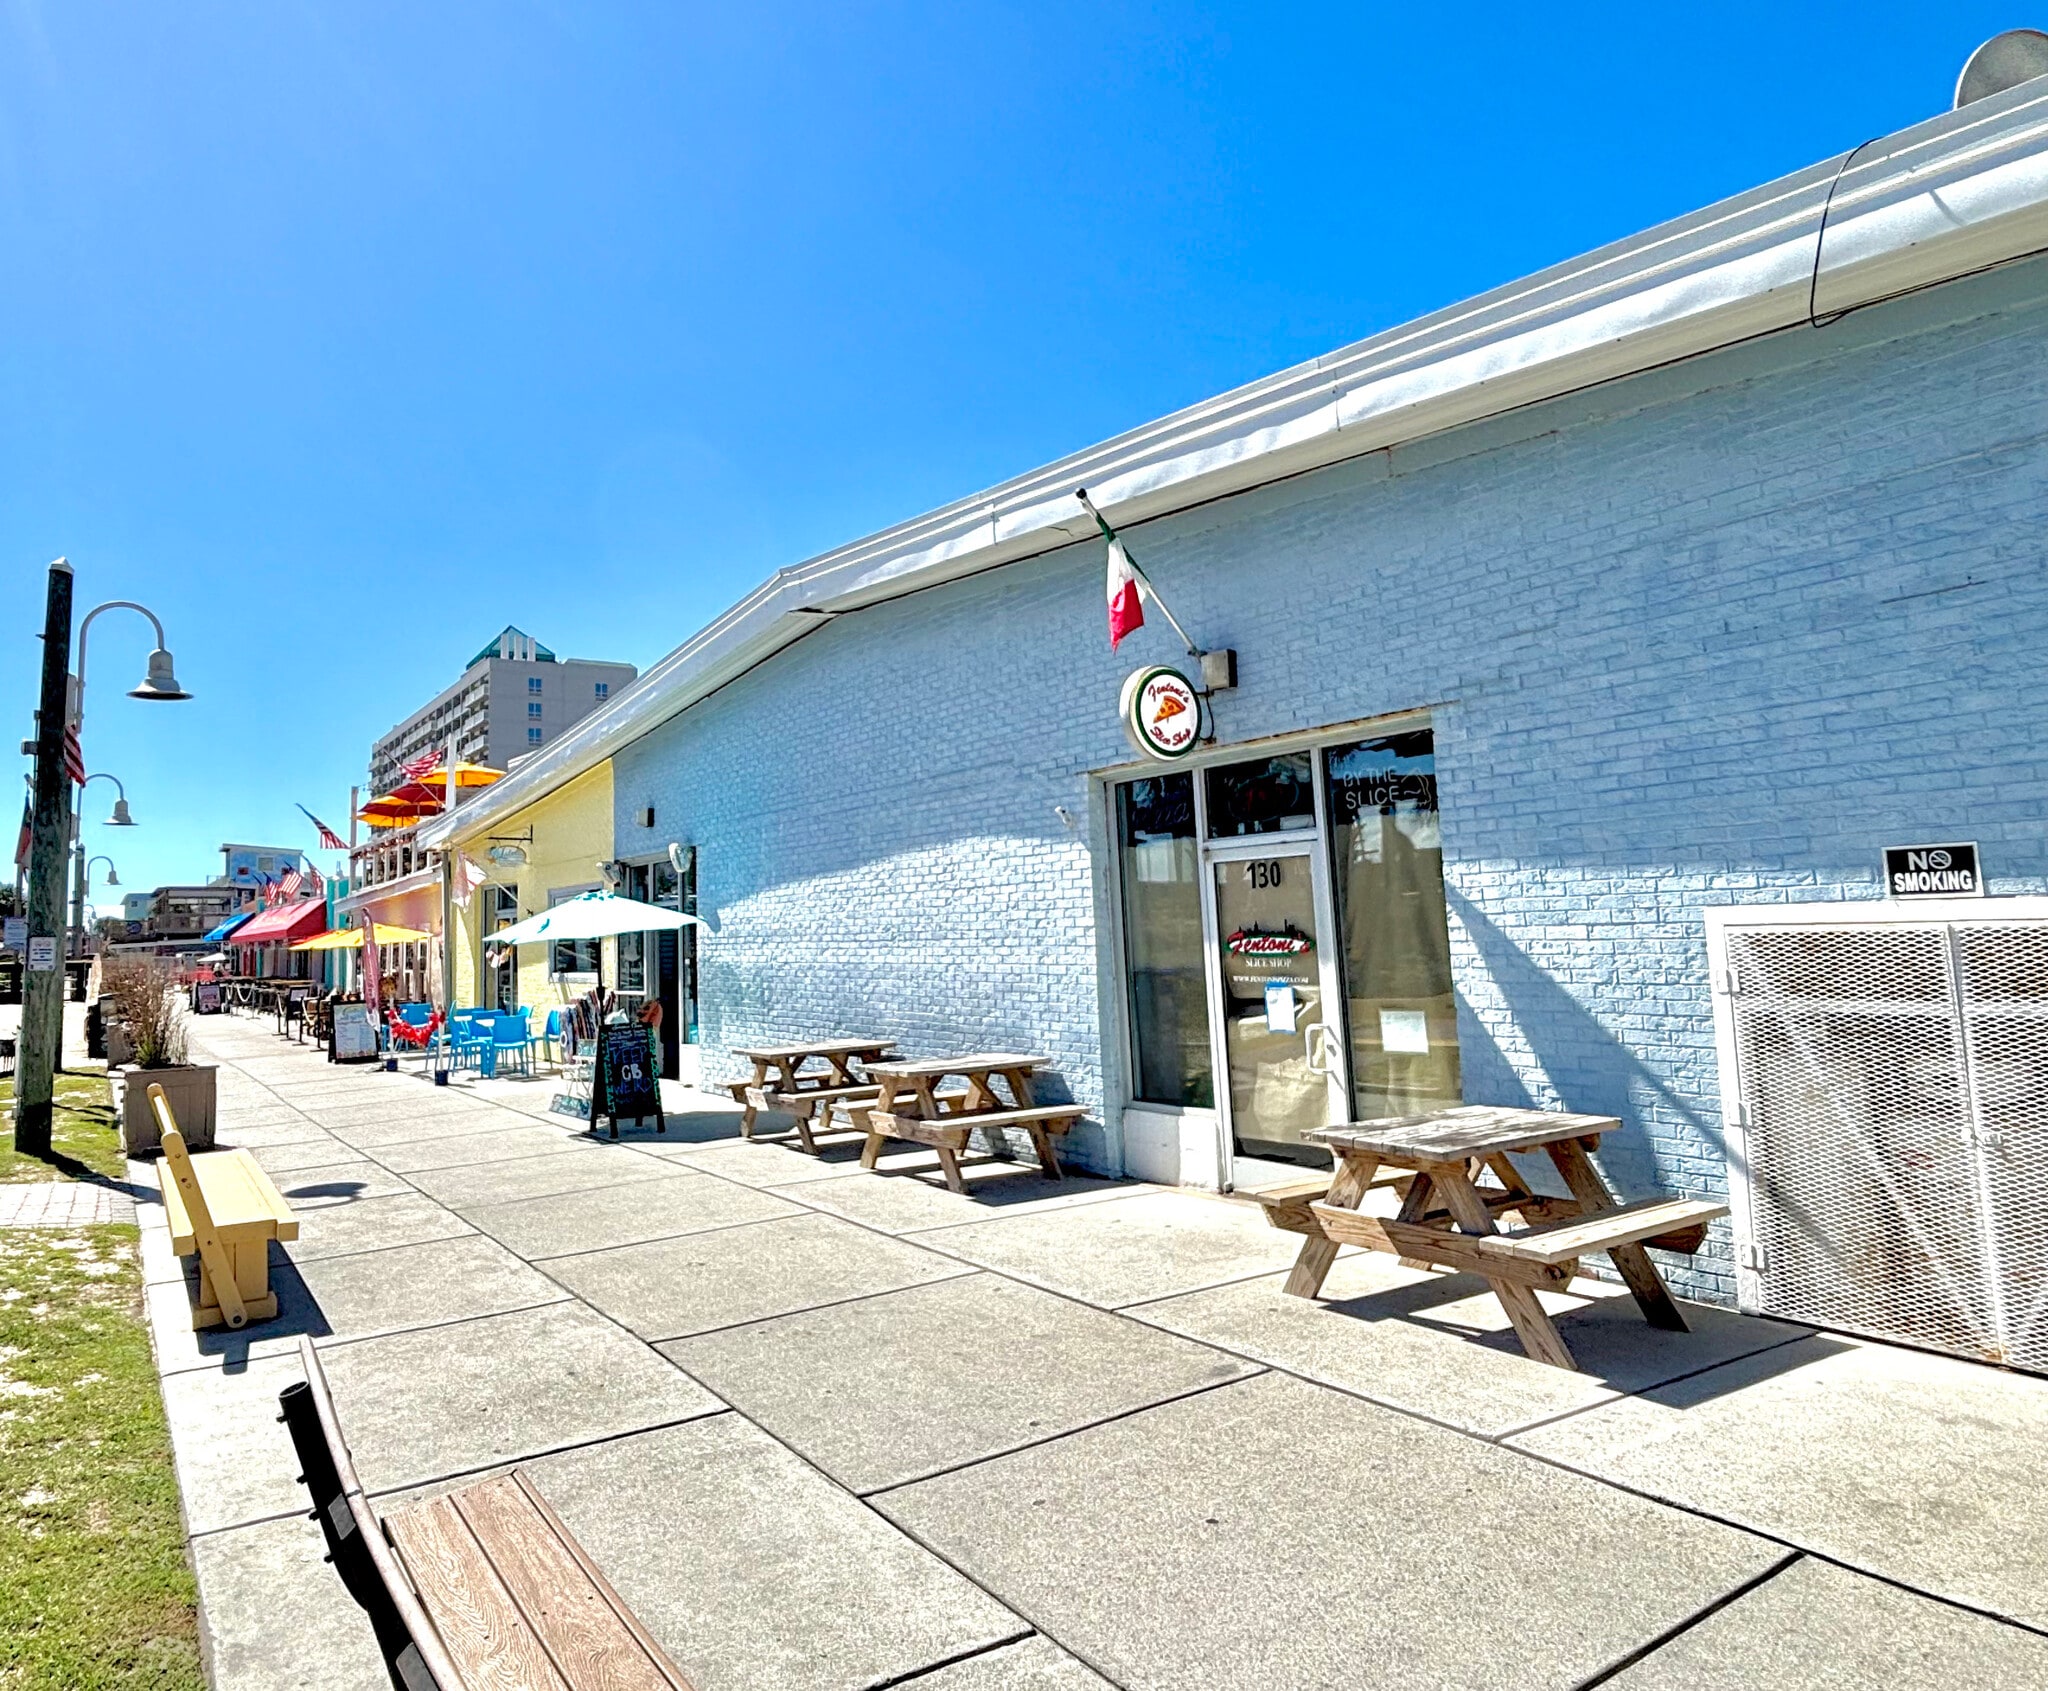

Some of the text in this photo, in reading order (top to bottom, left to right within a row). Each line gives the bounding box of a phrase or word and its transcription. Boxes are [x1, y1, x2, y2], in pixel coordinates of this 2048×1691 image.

[1147, 682, 1190, 703] Fentoni's
[1149, 726, 1192, 746] Slice Shop
[1366, 765, 1398, 785] THE
[1345, 785, 1400, 810] SLICE
[1246, 860, 1282, 889] 130
[1894, 869, 1974, 892] SMOKING
[1226, 930, 1311, 959] Fentoni's
[1245, 958, 1292, 968] SLICE SHOP
[612, 1046, 647, 1064] KEEP
[621, 1063, 643, 1081] CB
[614, 1076, 653, 1095] WEIRD
